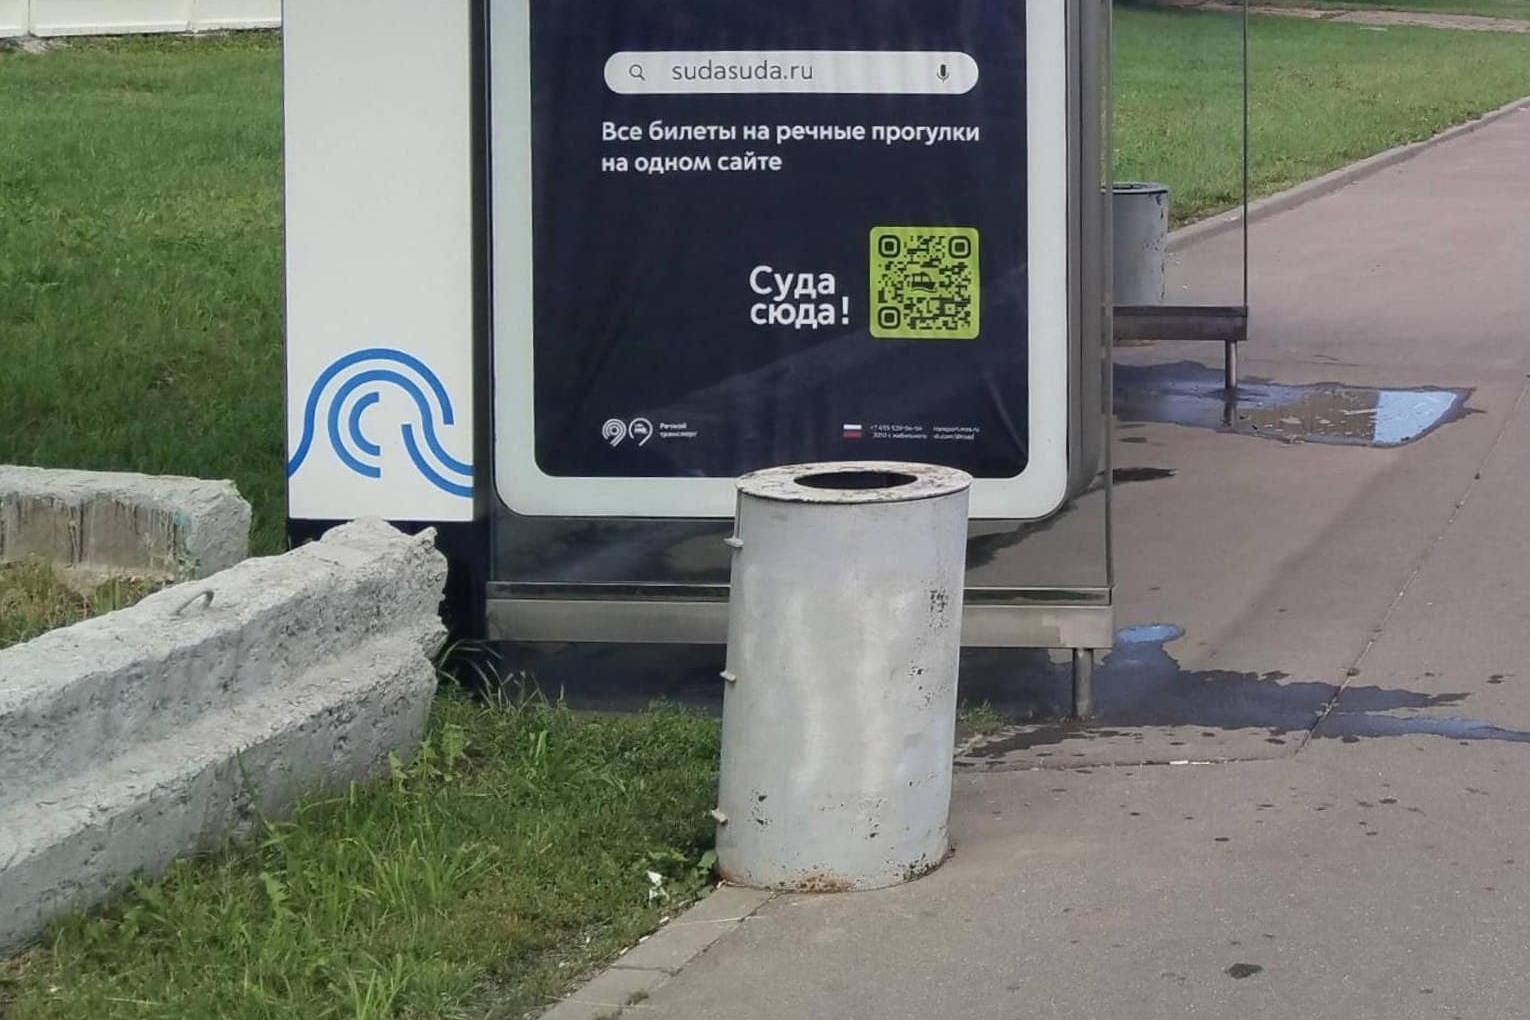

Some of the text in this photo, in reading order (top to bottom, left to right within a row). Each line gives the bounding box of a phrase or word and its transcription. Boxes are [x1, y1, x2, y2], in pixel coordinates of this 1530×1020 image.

[671, 60, 814, 81] sudasuda.ru
[602, 120, 980, 146] Все билеты на речные прогулки
[602, 151, 783, 175] на одном сайте
[749, 265, 836, 300] Суда
[750, 296, 849, 329] сюда!
